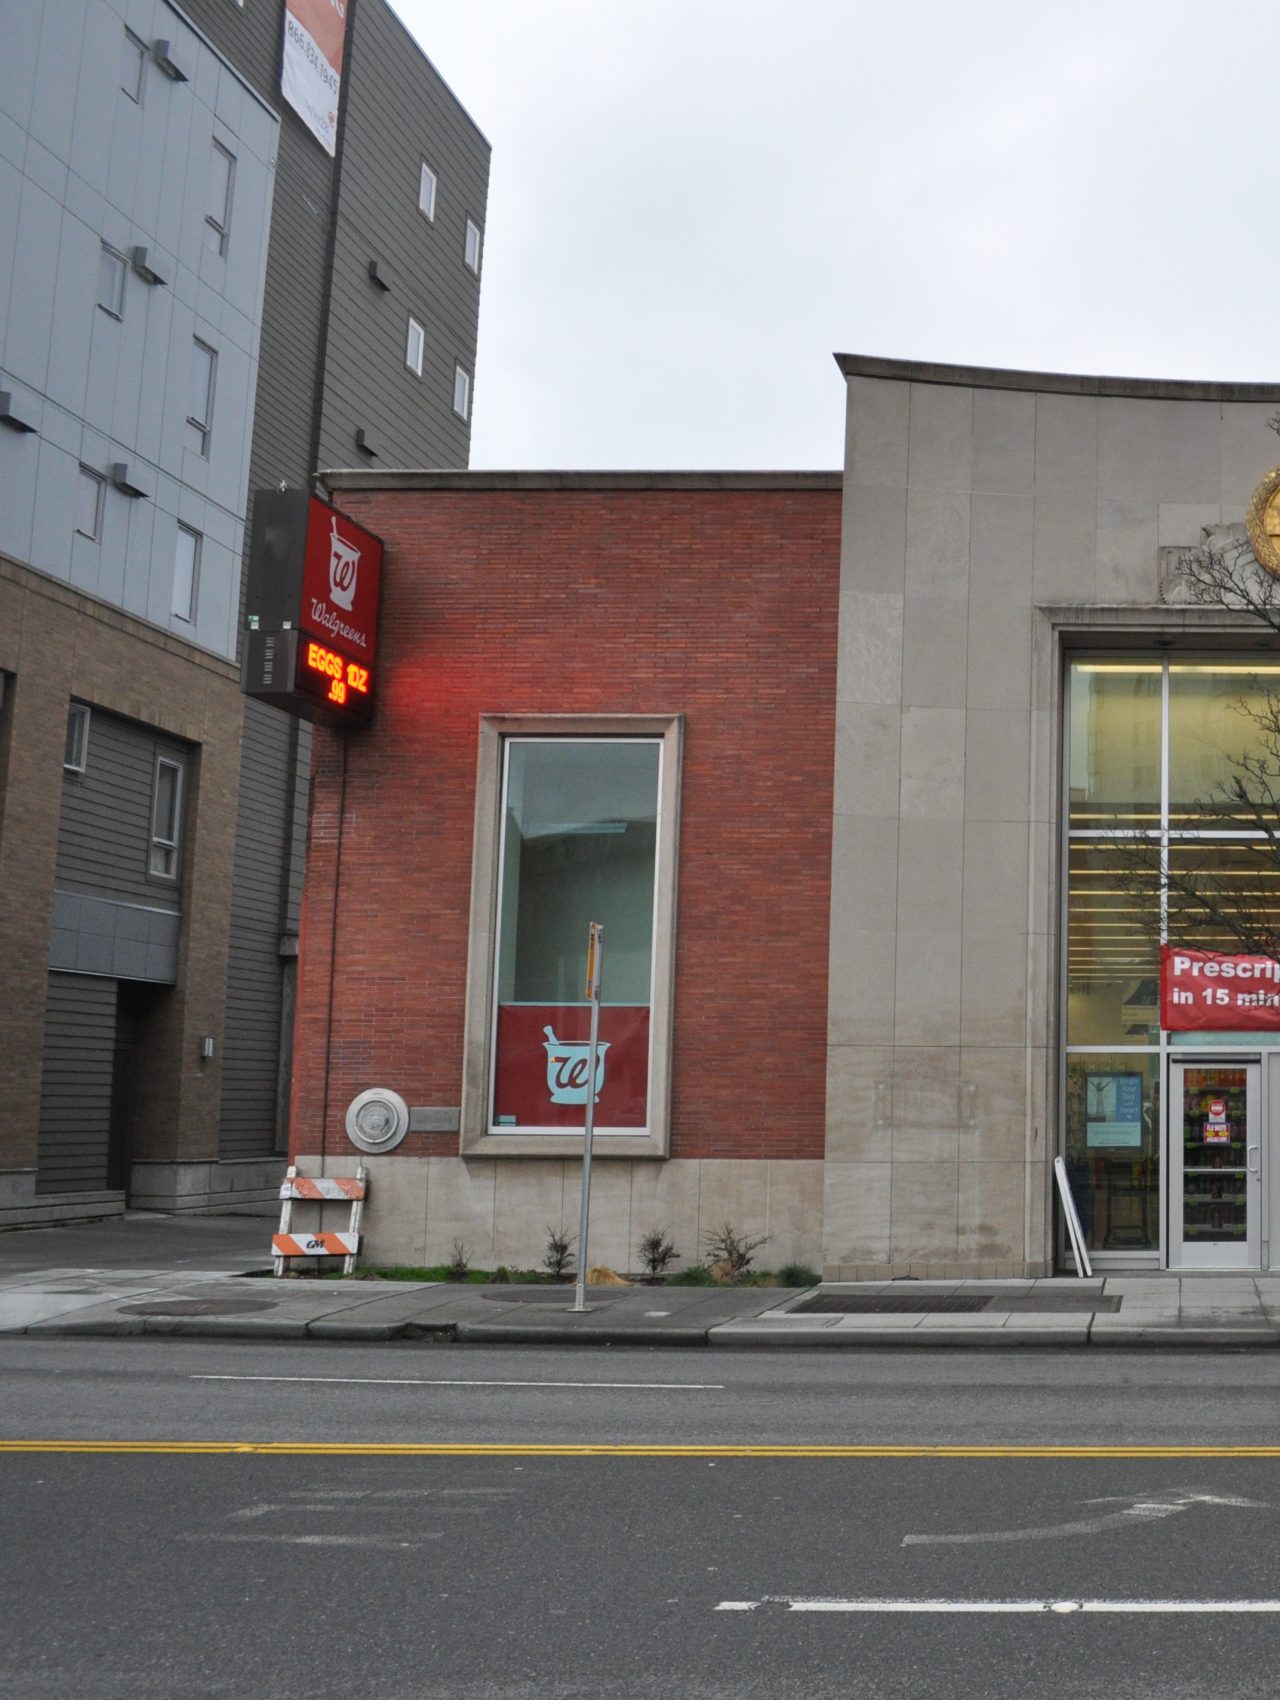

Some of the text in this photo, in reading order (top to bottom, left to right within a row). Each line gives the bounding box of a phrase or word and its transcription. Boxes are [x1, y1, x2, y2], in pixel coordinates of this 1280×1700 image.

[311, 597, 367, 648] Walgreens
[308, 642, 342, 679] EGGS
[328, 679, 347, 705] .99
[1172, 988, 1194, 1006] in
[1202, 988, 1230, 1006] 15
